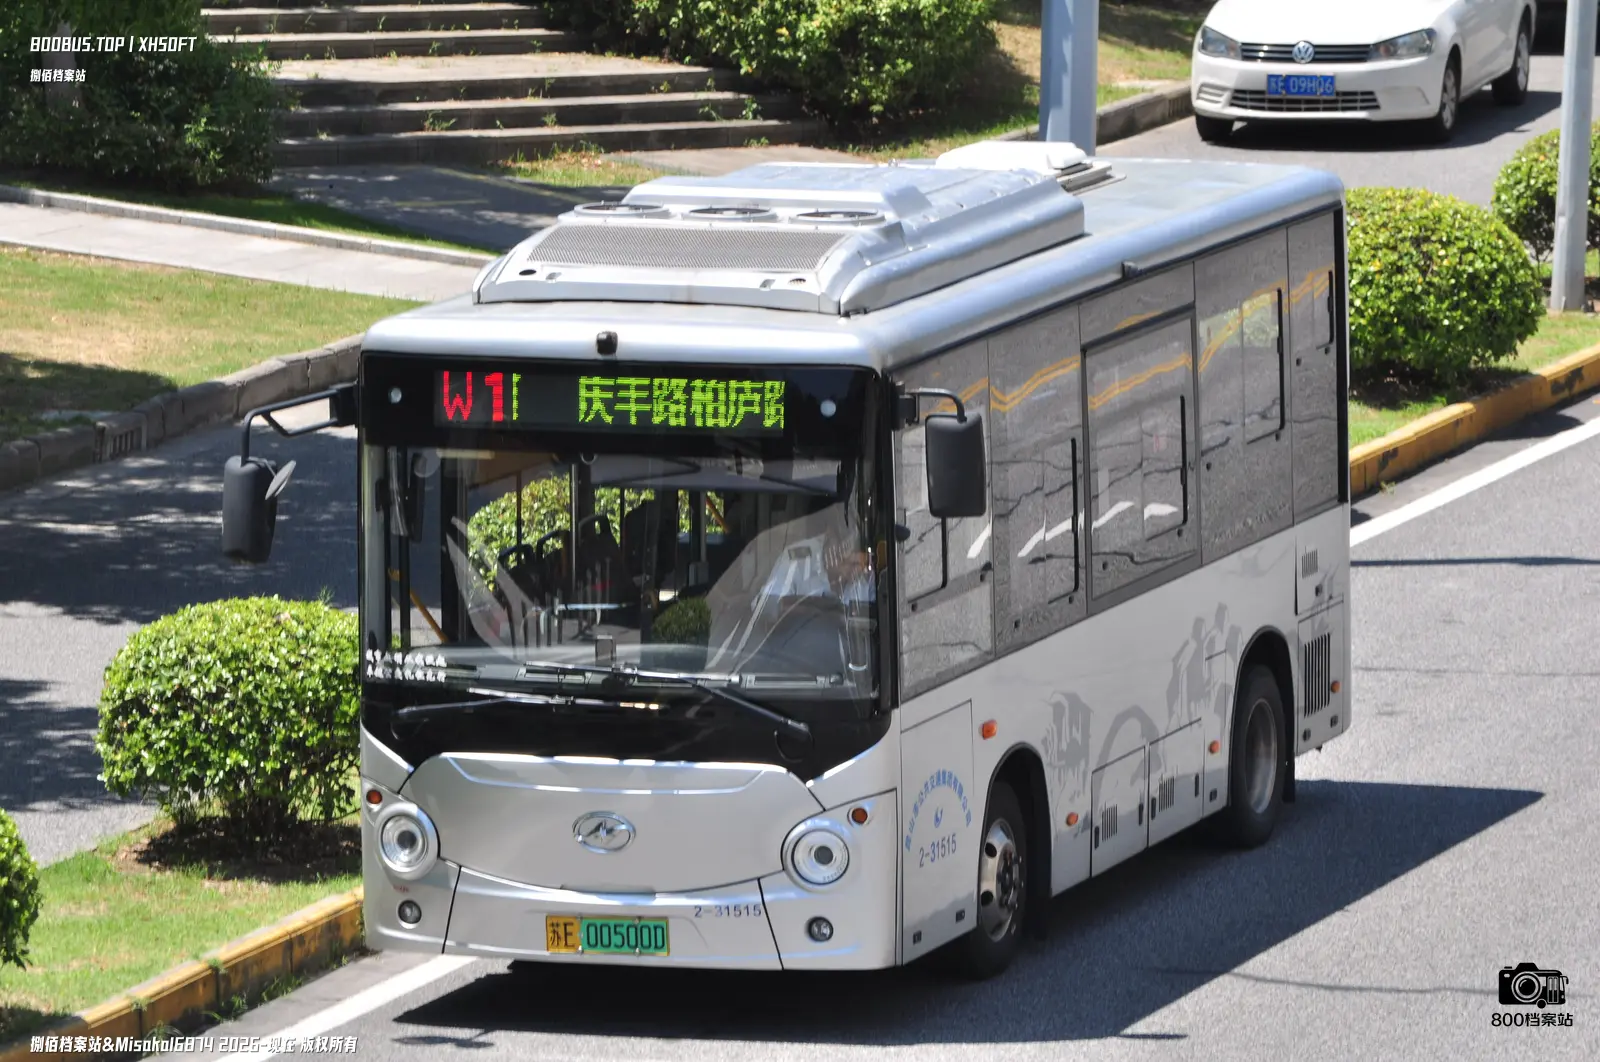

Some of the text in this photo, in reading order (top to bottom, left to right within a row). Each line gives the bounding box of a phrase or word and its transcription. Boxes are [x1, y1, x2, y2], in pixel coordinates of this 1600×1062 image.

[443, 371, 504, 422] W1
[919, 832, 957, 869] 2-31515
[694, 904, 762, 918] 2-31515
